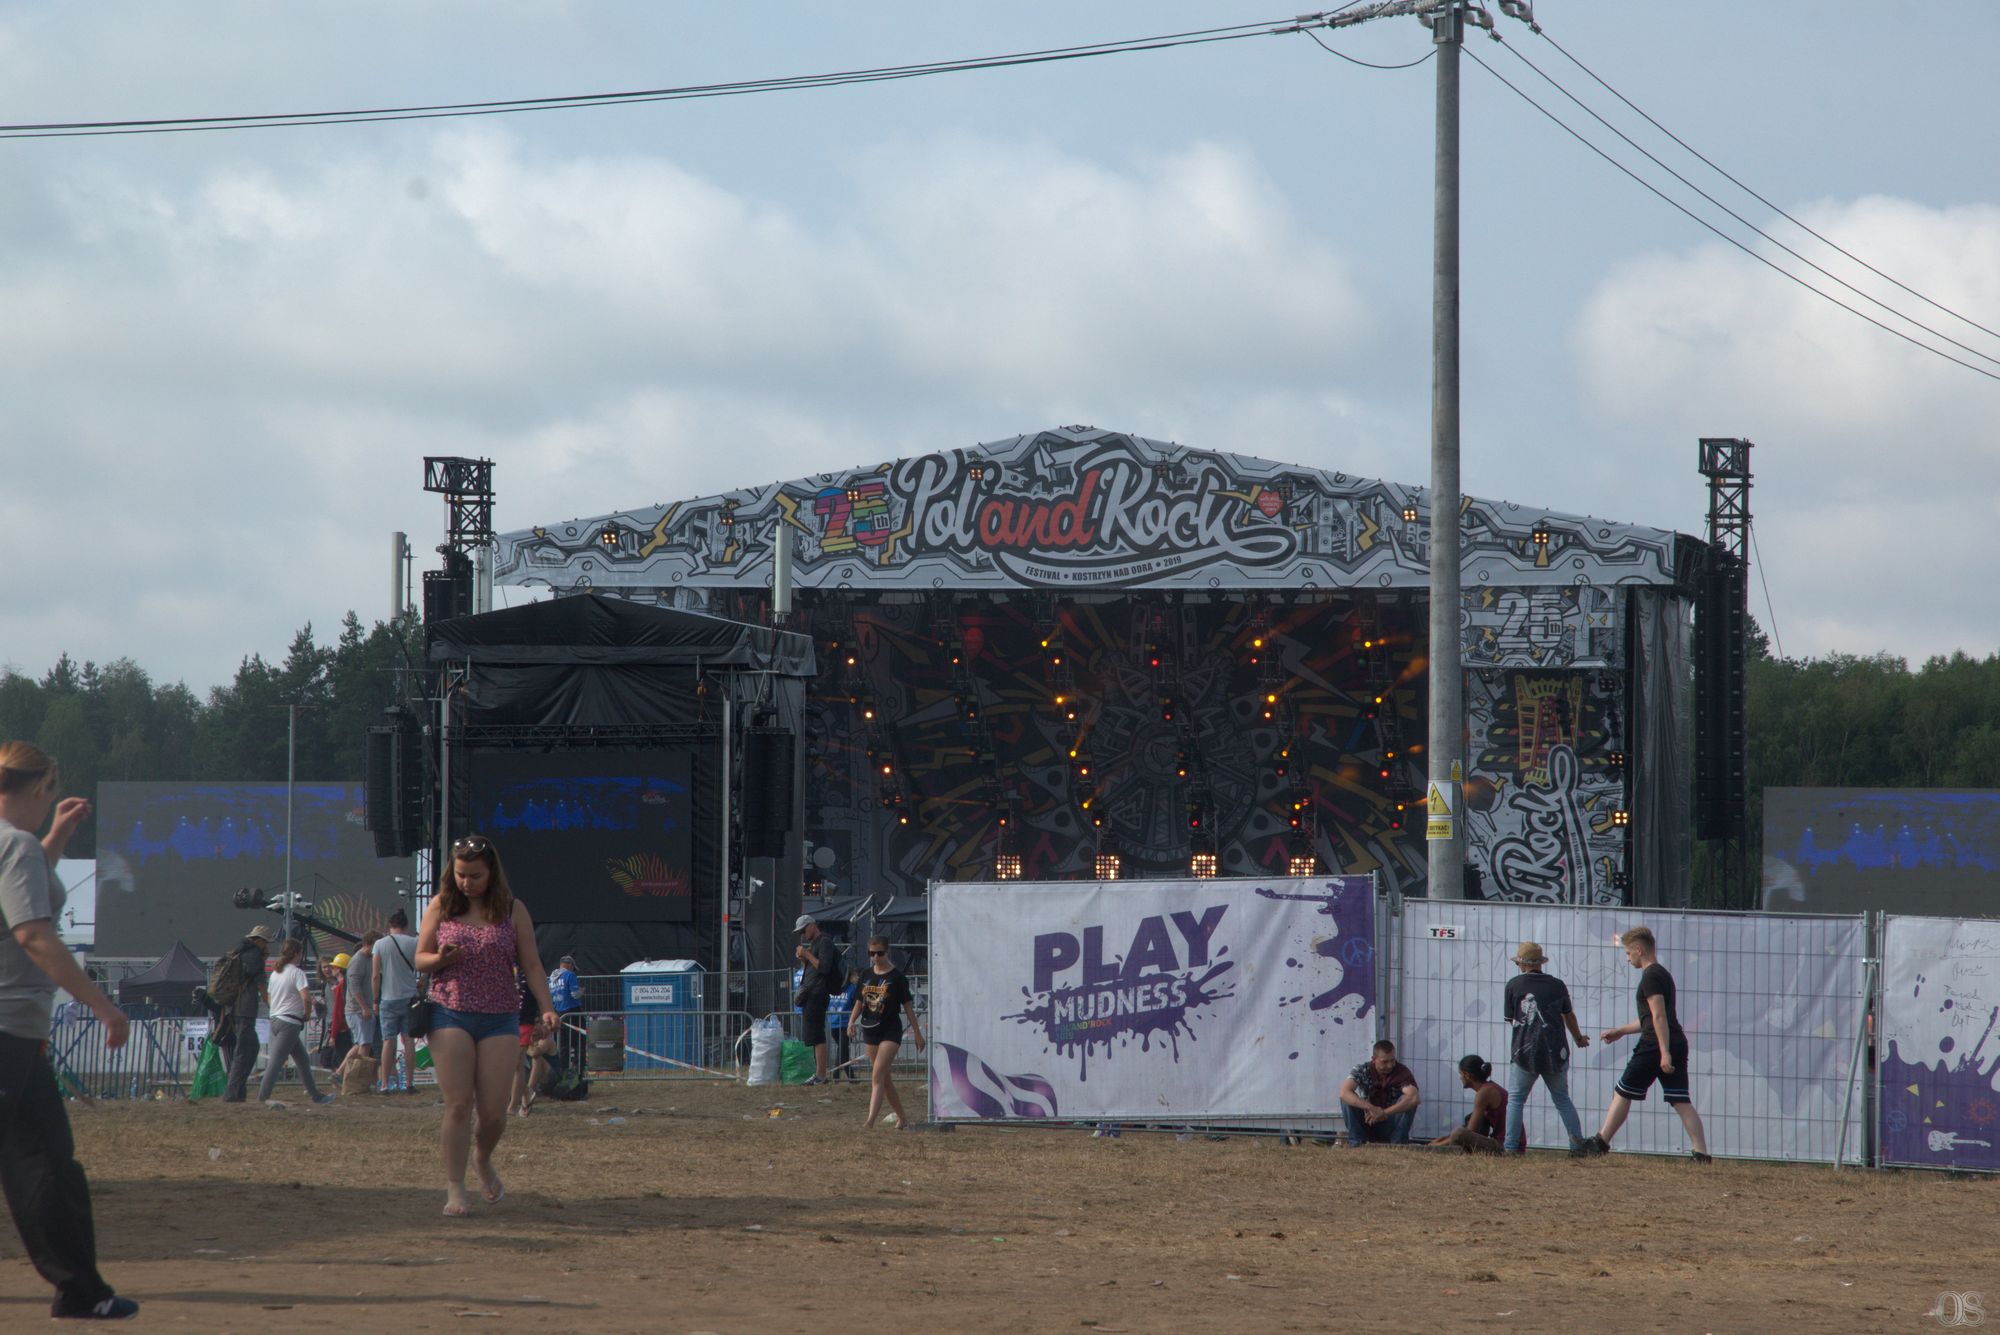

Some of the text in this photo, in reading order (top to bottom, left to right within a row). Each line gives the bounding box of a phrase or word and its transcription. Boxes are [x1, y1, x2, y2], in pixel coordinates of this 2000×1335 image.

[1025, 566, 1061, 581] FESTIVAL
[1072, 570, 1112, 581] KOSTRZYN
[1113, 568, 1130, 578] NAD
[1163, 555, 1182, 567] 2019
[1033, 904, 1230, 994] PLAY
[1430, 928, 1455, 938] TFS
[1054, 979, 1188, 1025] MUDNESS
